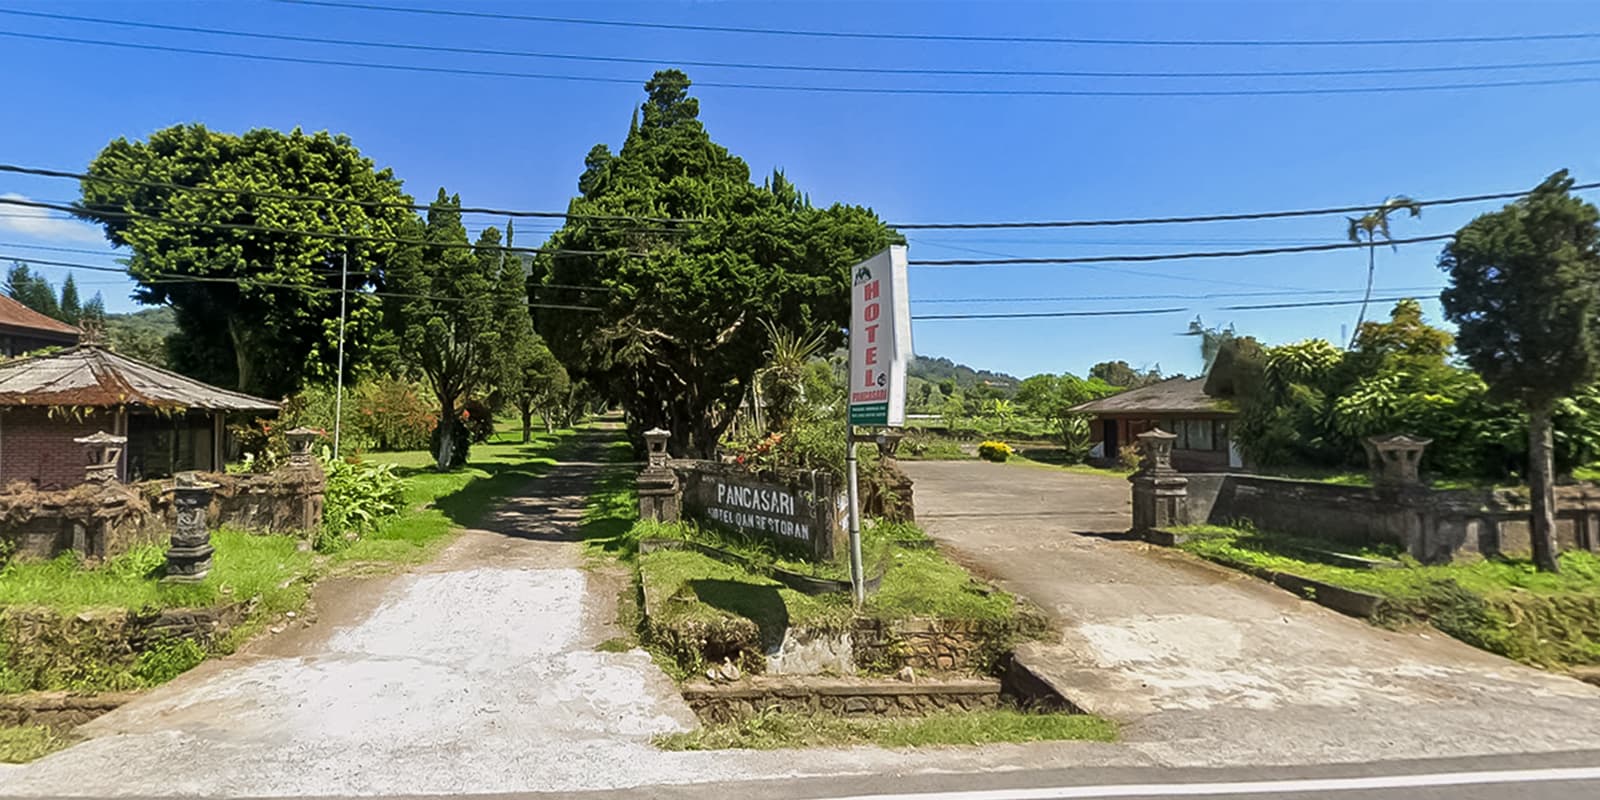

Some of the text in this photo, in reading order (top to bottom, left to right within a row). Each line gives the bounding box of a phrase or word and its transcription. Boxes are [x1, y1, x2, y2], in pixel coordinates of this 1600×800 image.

[864, 280, 880, 387] HOTEL
[852, 389, 886, 403] PANCASARI
[717, 483, 794, 515] PANCASARI
[755, 515, 809, 540] RESTORAN
